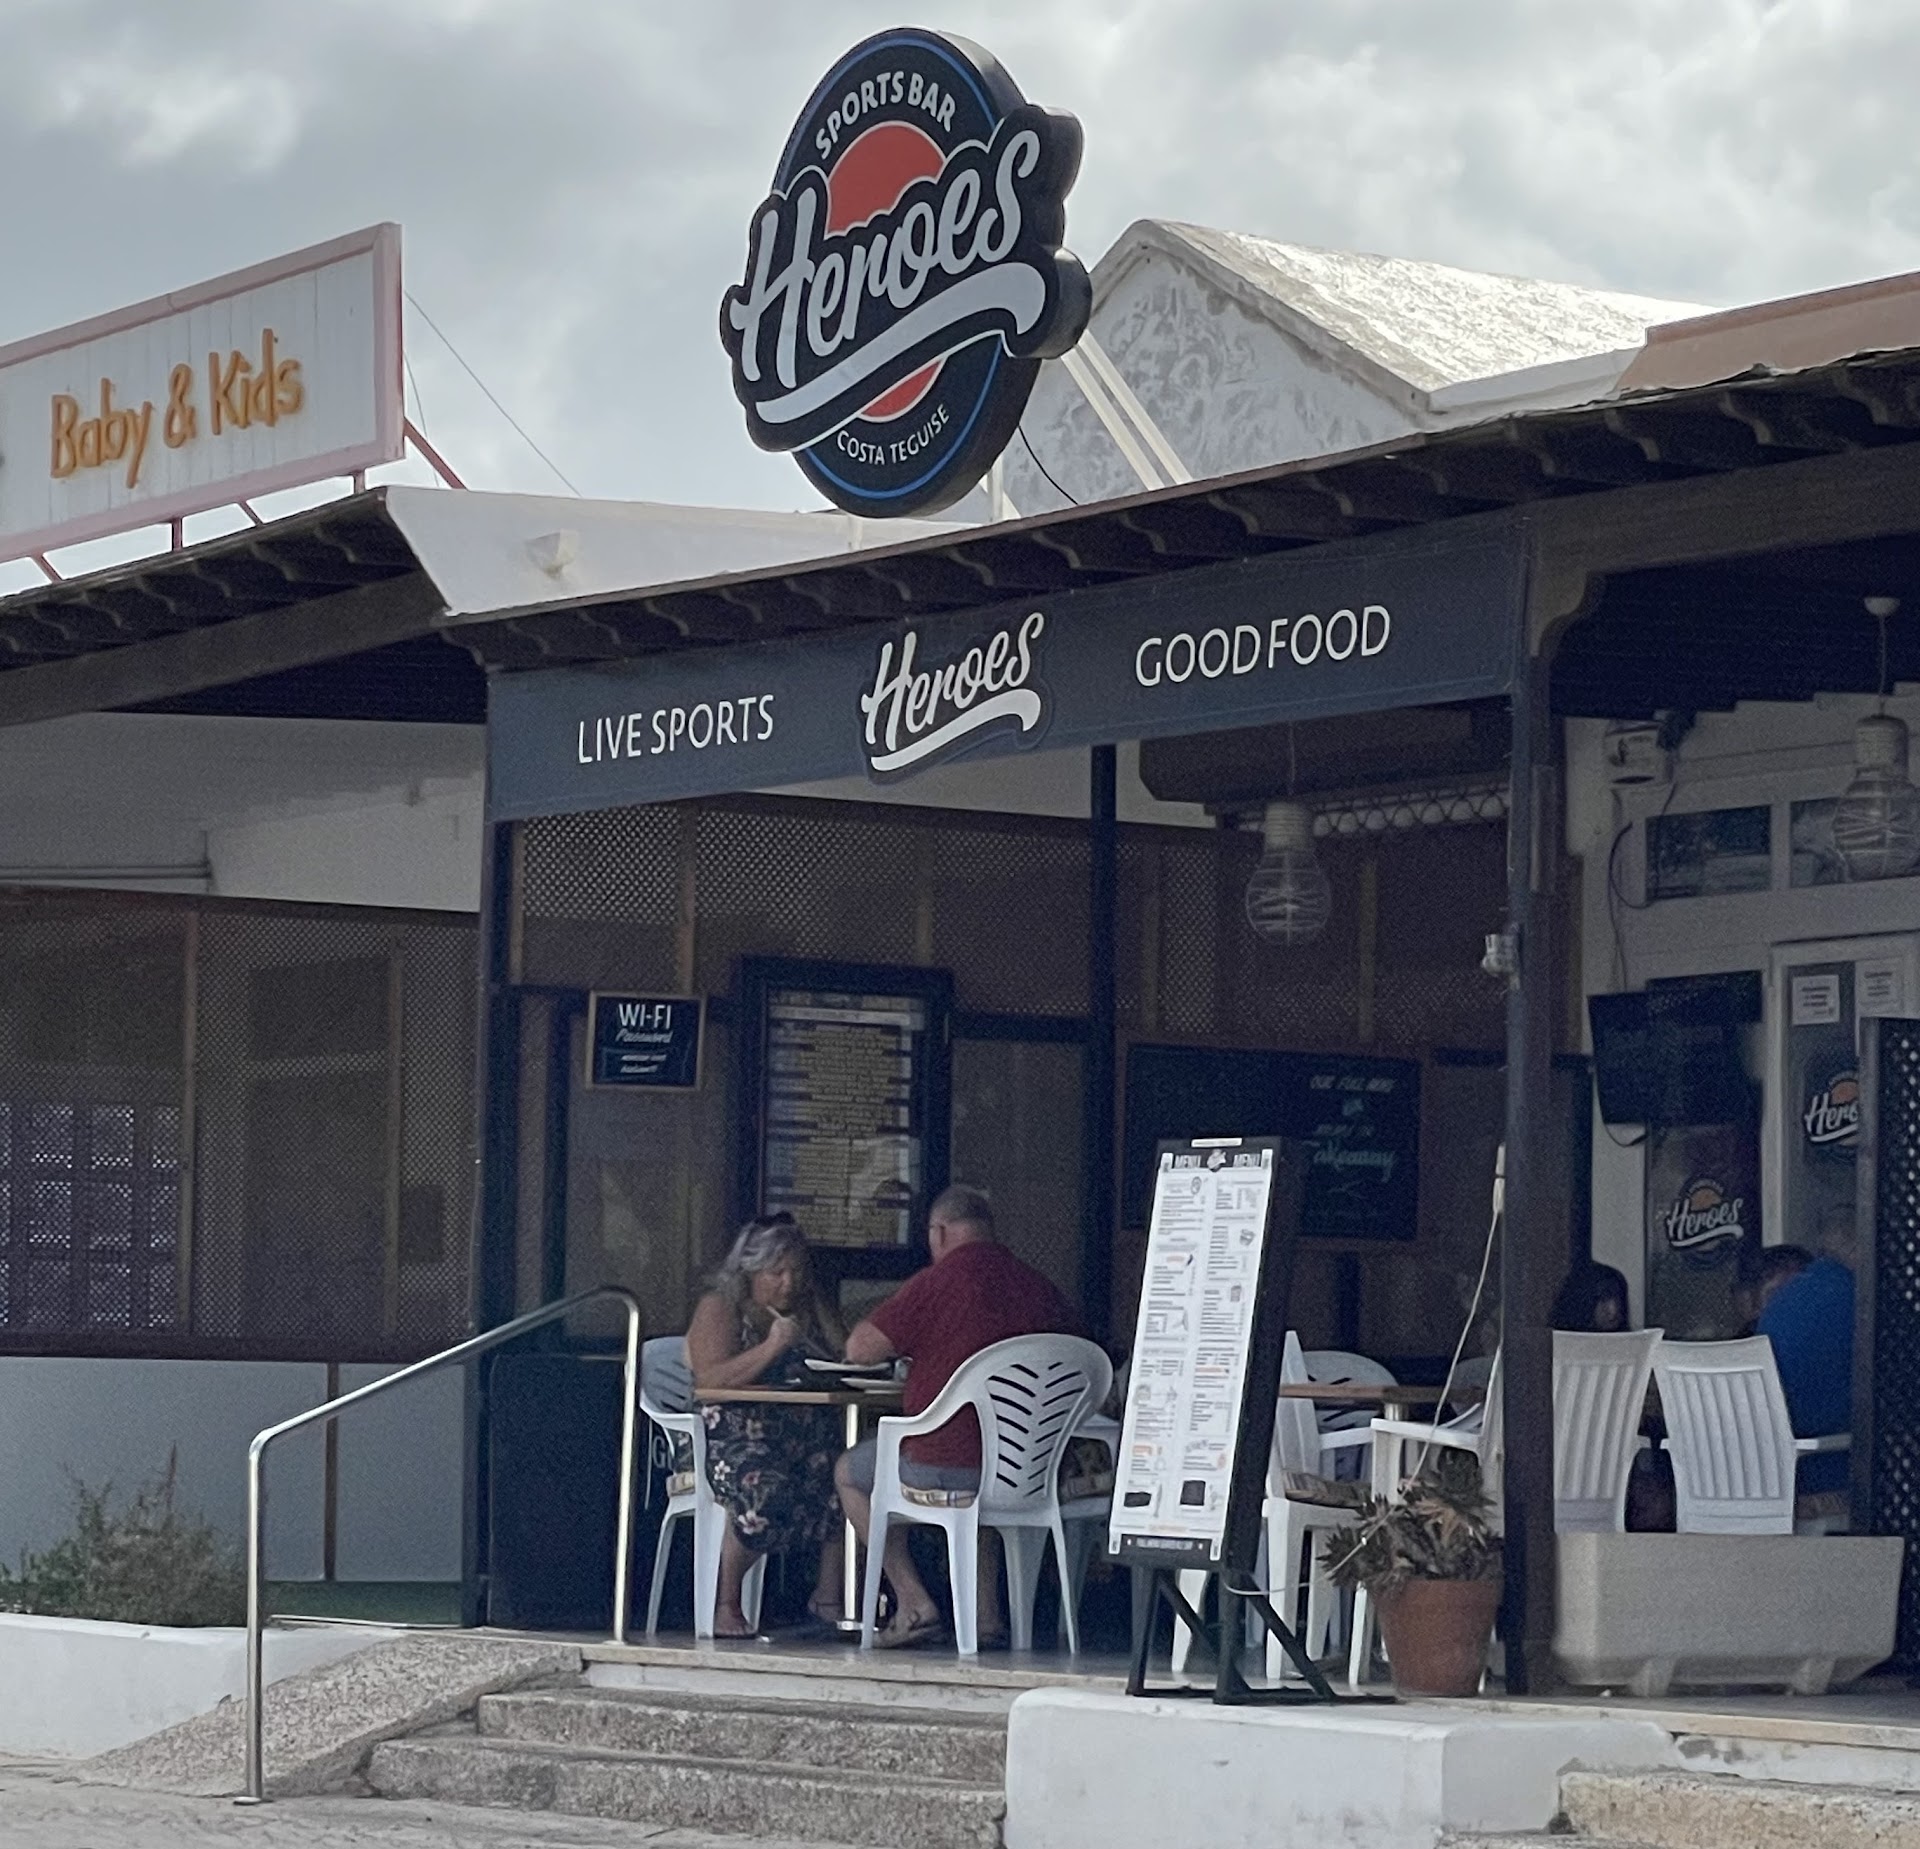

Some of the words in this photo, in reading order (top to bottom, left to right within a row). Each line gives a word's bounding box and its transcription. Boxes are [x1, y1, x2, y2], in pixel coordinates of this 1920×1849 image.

[816, 71, 905, 159] SPORTS
[908, 73, 957, 132] BAR
[730, 130, 1040, 388] Heroes
[50, 377, 154, 489] Baby
[164, 363, 196, 449] &
[208, 328, 305, 436] Kids
[838, 430, 885, 466] COSTA
[890, 403, 950, 463] TEGUISE
[861, 611, 1045, 752] Heroes
[1135, 624, 1261, 687] GOOD
[1267, 604, 1391, 669] FOOD
[577, 712, 642, 764] LIVE
[650, 694, 774, 755] SPORTS
[618, 1002, 672, 1029] WI-FI
[1804, 1092, 1858, 1135] Hero
[1666, 1197, 1744, 1241] Heroes
